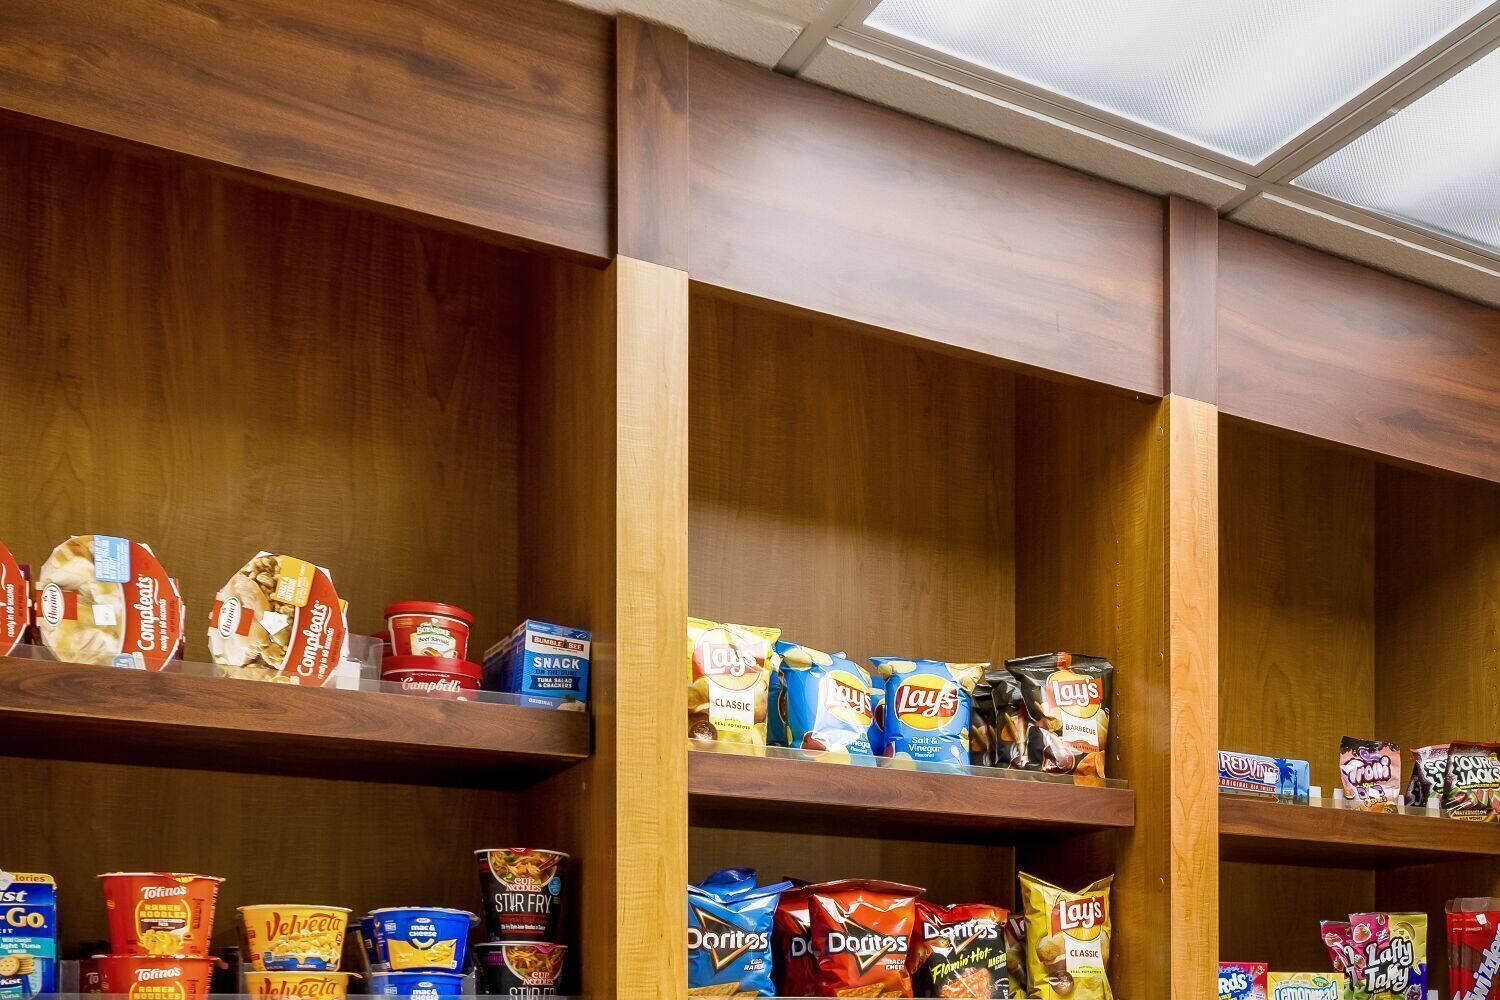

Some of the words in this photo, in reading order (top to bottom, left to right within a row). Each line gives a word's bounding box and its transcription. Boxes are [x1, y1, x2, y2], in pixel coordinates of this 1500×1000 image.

[133, 574, 155, 651] Compleats
[297, 600, 328, 677] Compleats
[533, 636, 563, 648] BUMBLE
[568, 642, 582, 651] BEE
[533, 656, 580, 670] SNACK
[898, 682, 960, 718] Lay's
[1054, 677, 1100, 707] Lay's
[528, 697, 554, 706] ORIGINAL
[714, 698, 751, 712] CLASSIC
[1065, 724, 1097, 736] BARBECUE
[908, 743, 942, 754] Vinegar
[911, 736, 930, 745] Salt
[931, 736, 938, 745] &
[1219, 751, 1249, 771] RED
[1342, 755, 1391, 784] Trolli
[1456, 767, 1500, 786] JACKS
[1221, 778, 1249, 789] ORIGINAL
[505, 884, 542, 892] NOODLES
[514, 877, 535, 885] CUP
[140, 886, 187, 899] Totino's
[494, 893, 525, 913] STIR
[527, 893, 552, 914] FRY
[1059, 897, 1102, 931] Lay's
[266, 911, 343, 941] Velveeta
[923, 918, 999, 940] Doritos
[688, 927, 769, 950] Doritos
[828, 932, 908, 953] Doritos
[970, 947, 993, 963] Hot
[1069, 949, 1099, 958] CLASSIC
[1365, 937, 1412, 966] Laffy
[135, 967, 182, 981] Totino's
[522, 978, 554, 986] NOODLES
[531, 971, 550, 979] CUP
[1364, 962, 1410, 992] Taffy
